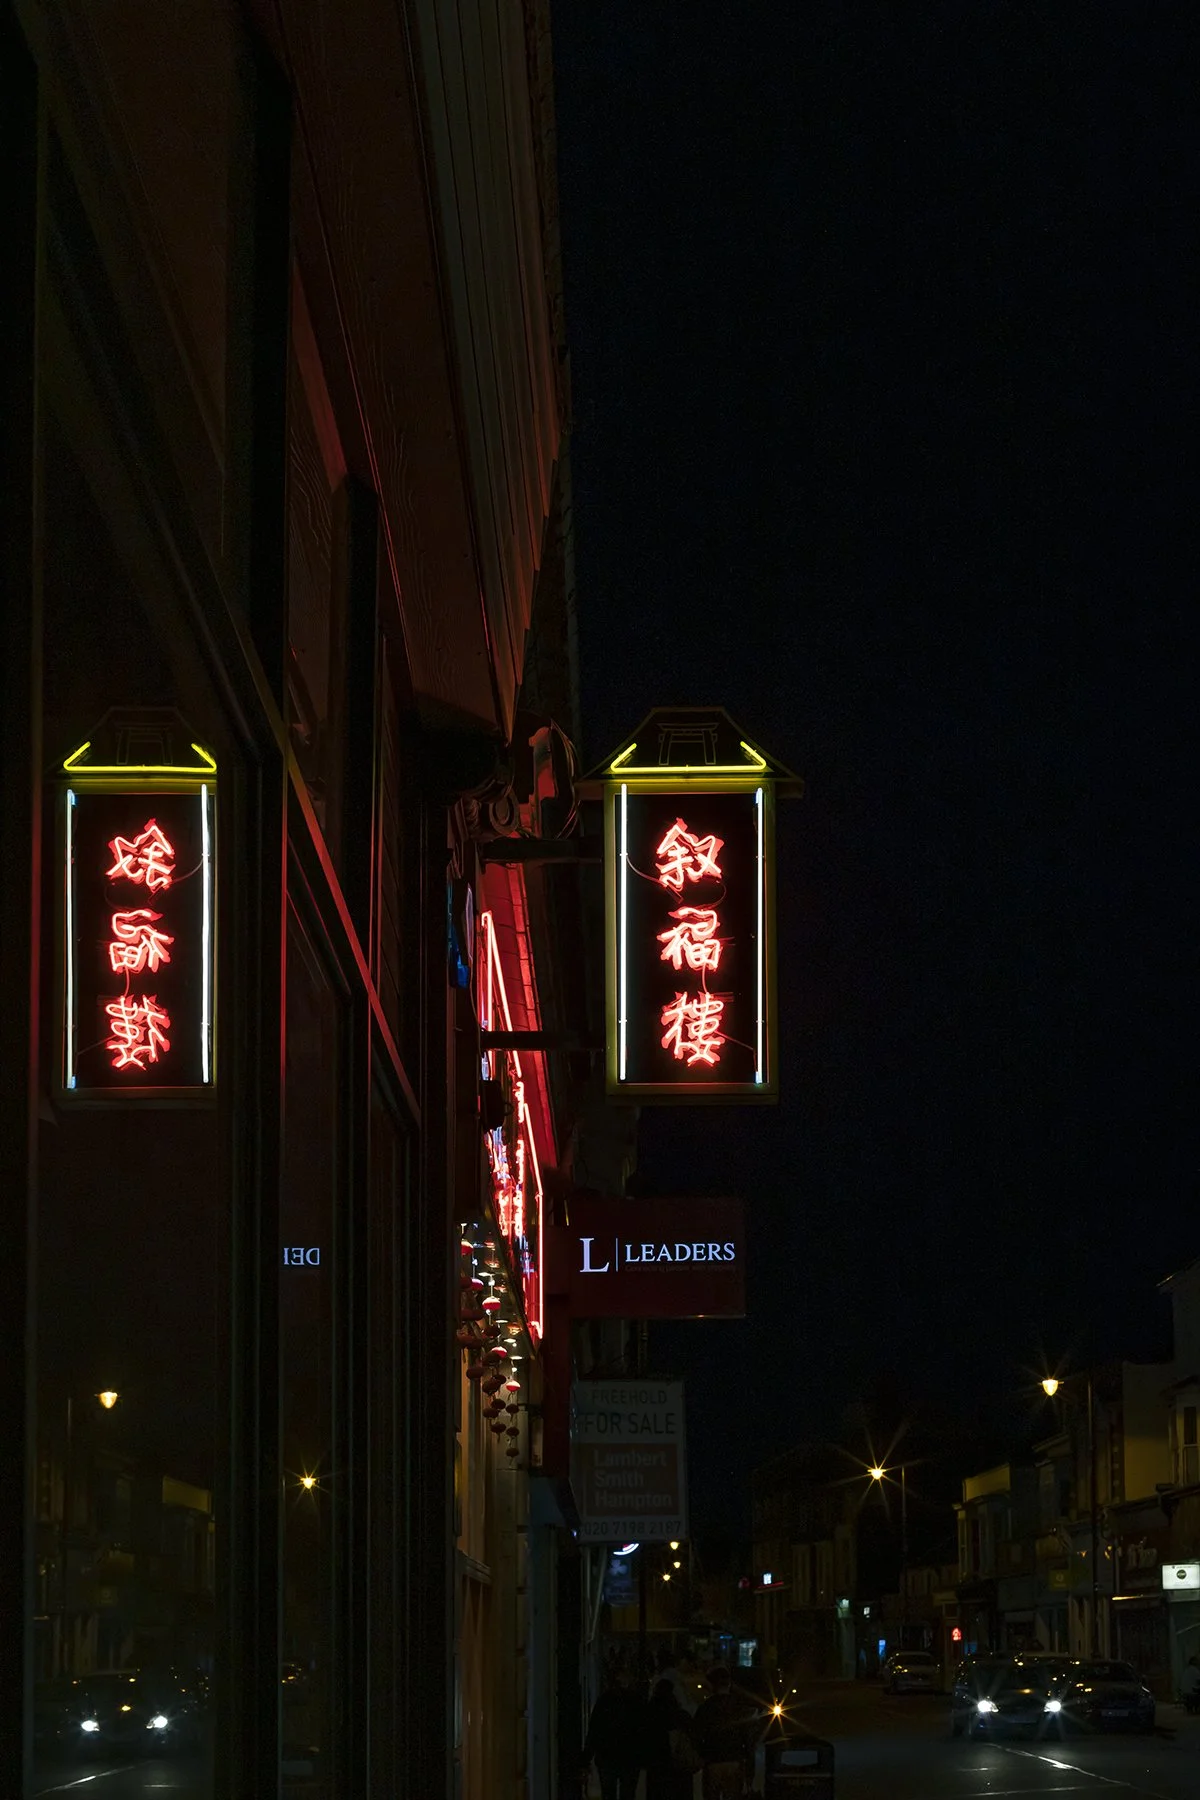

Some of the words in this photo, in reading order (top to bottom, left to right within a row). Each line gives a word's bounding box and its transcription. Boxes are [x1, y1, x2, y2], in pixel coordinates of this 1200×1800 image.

[579, 1237, 610, 1273] L
[625, 1242, 736, 1263] LEADERS
[591, 1388, 667, 1405] FREEHOLD
[584, 1412, 622, 1434] FOR
[628, 1412, 677, 1434] SALE
[593, 1449, 668, 1467] Lambert
[594, 1469, 644, 1488] Smith
[595, 1491, 674, 1510] Hampton
[584, 1521, 609, 1536] 020
